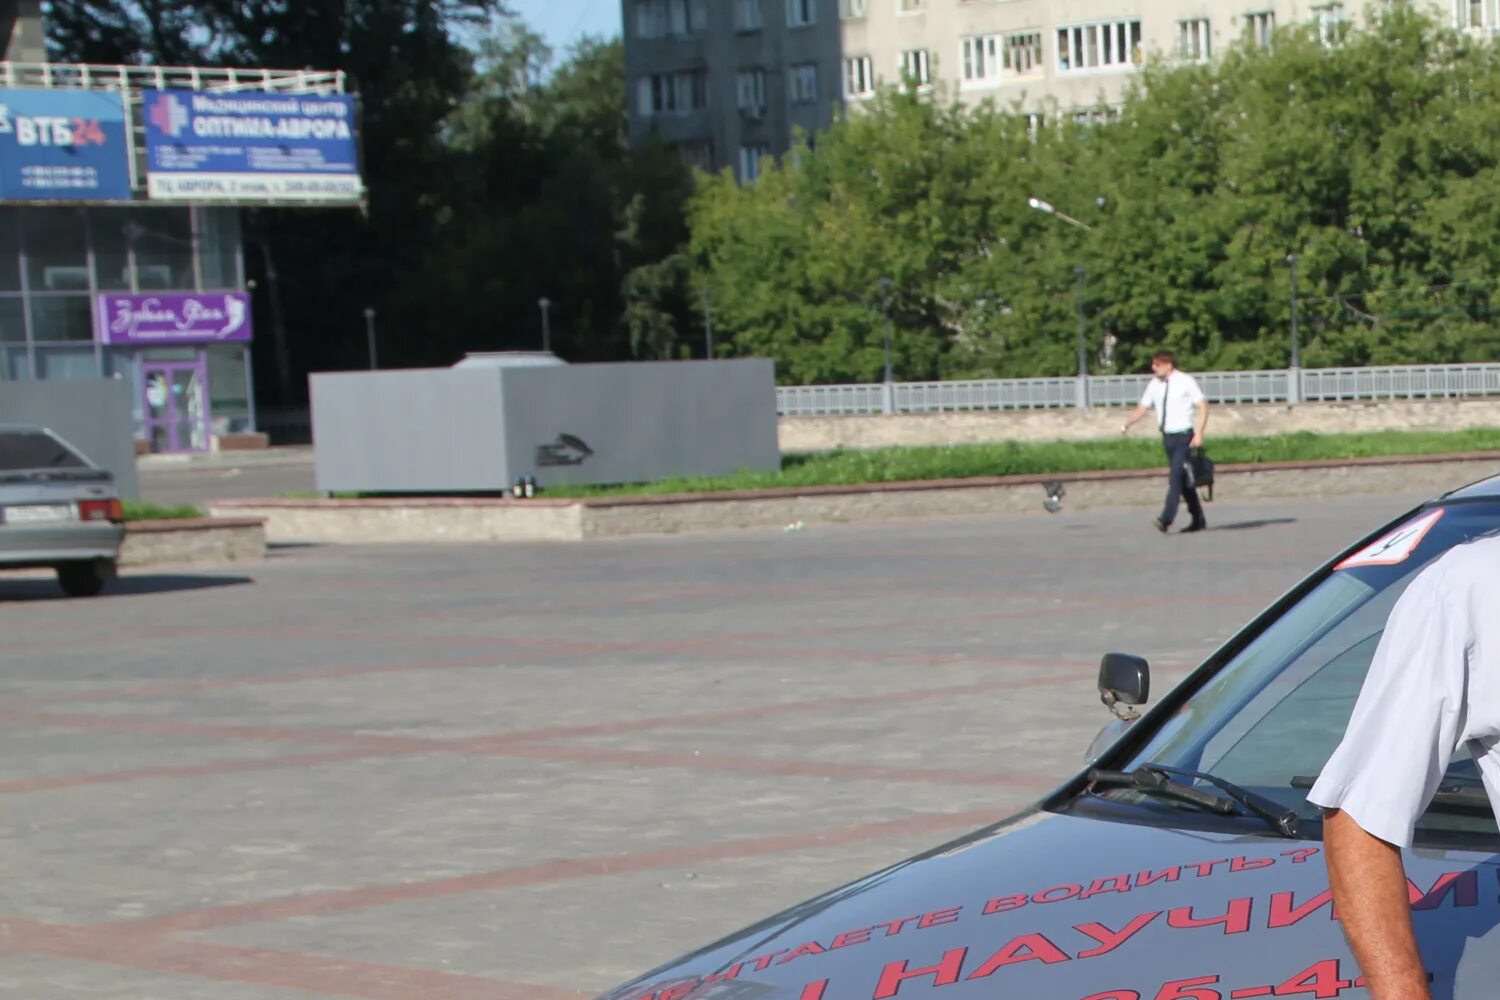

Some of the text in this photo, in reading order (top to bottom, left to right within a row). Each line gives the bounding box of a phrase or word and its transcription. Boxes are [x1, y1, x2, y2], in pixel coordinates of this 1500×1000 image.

[16, 115, 106, 147] ВТБ24
[193, 115, 351, 140] ОПТИМА-АВРОРА
[981, 847, 1321, 915] ВОДИТЬ?
